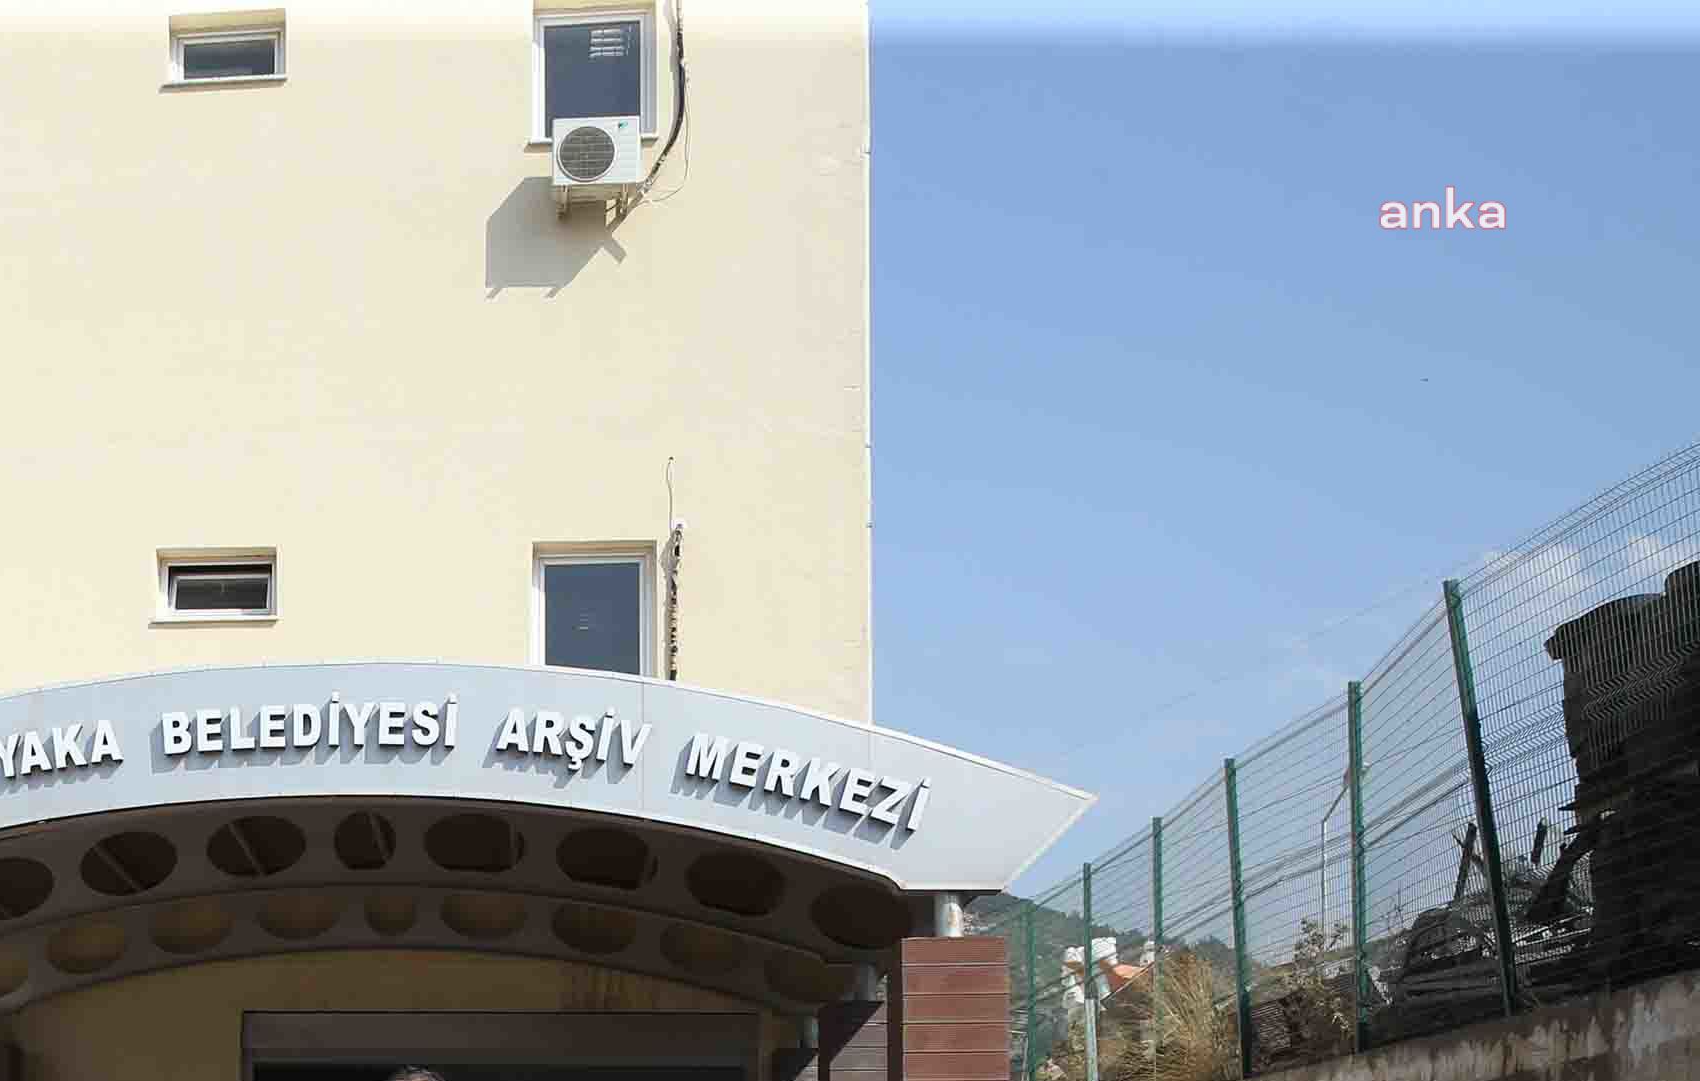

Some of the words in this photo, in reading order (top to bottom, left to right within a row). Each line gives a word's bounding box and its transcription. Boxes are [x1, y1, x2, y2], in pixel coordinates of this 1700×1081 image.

[161, 692, 458, 756] BELEDİYESİ
[495, 706, 653, 770] ARŞİV
[686, 734, 932, 832] MERKEZİ
